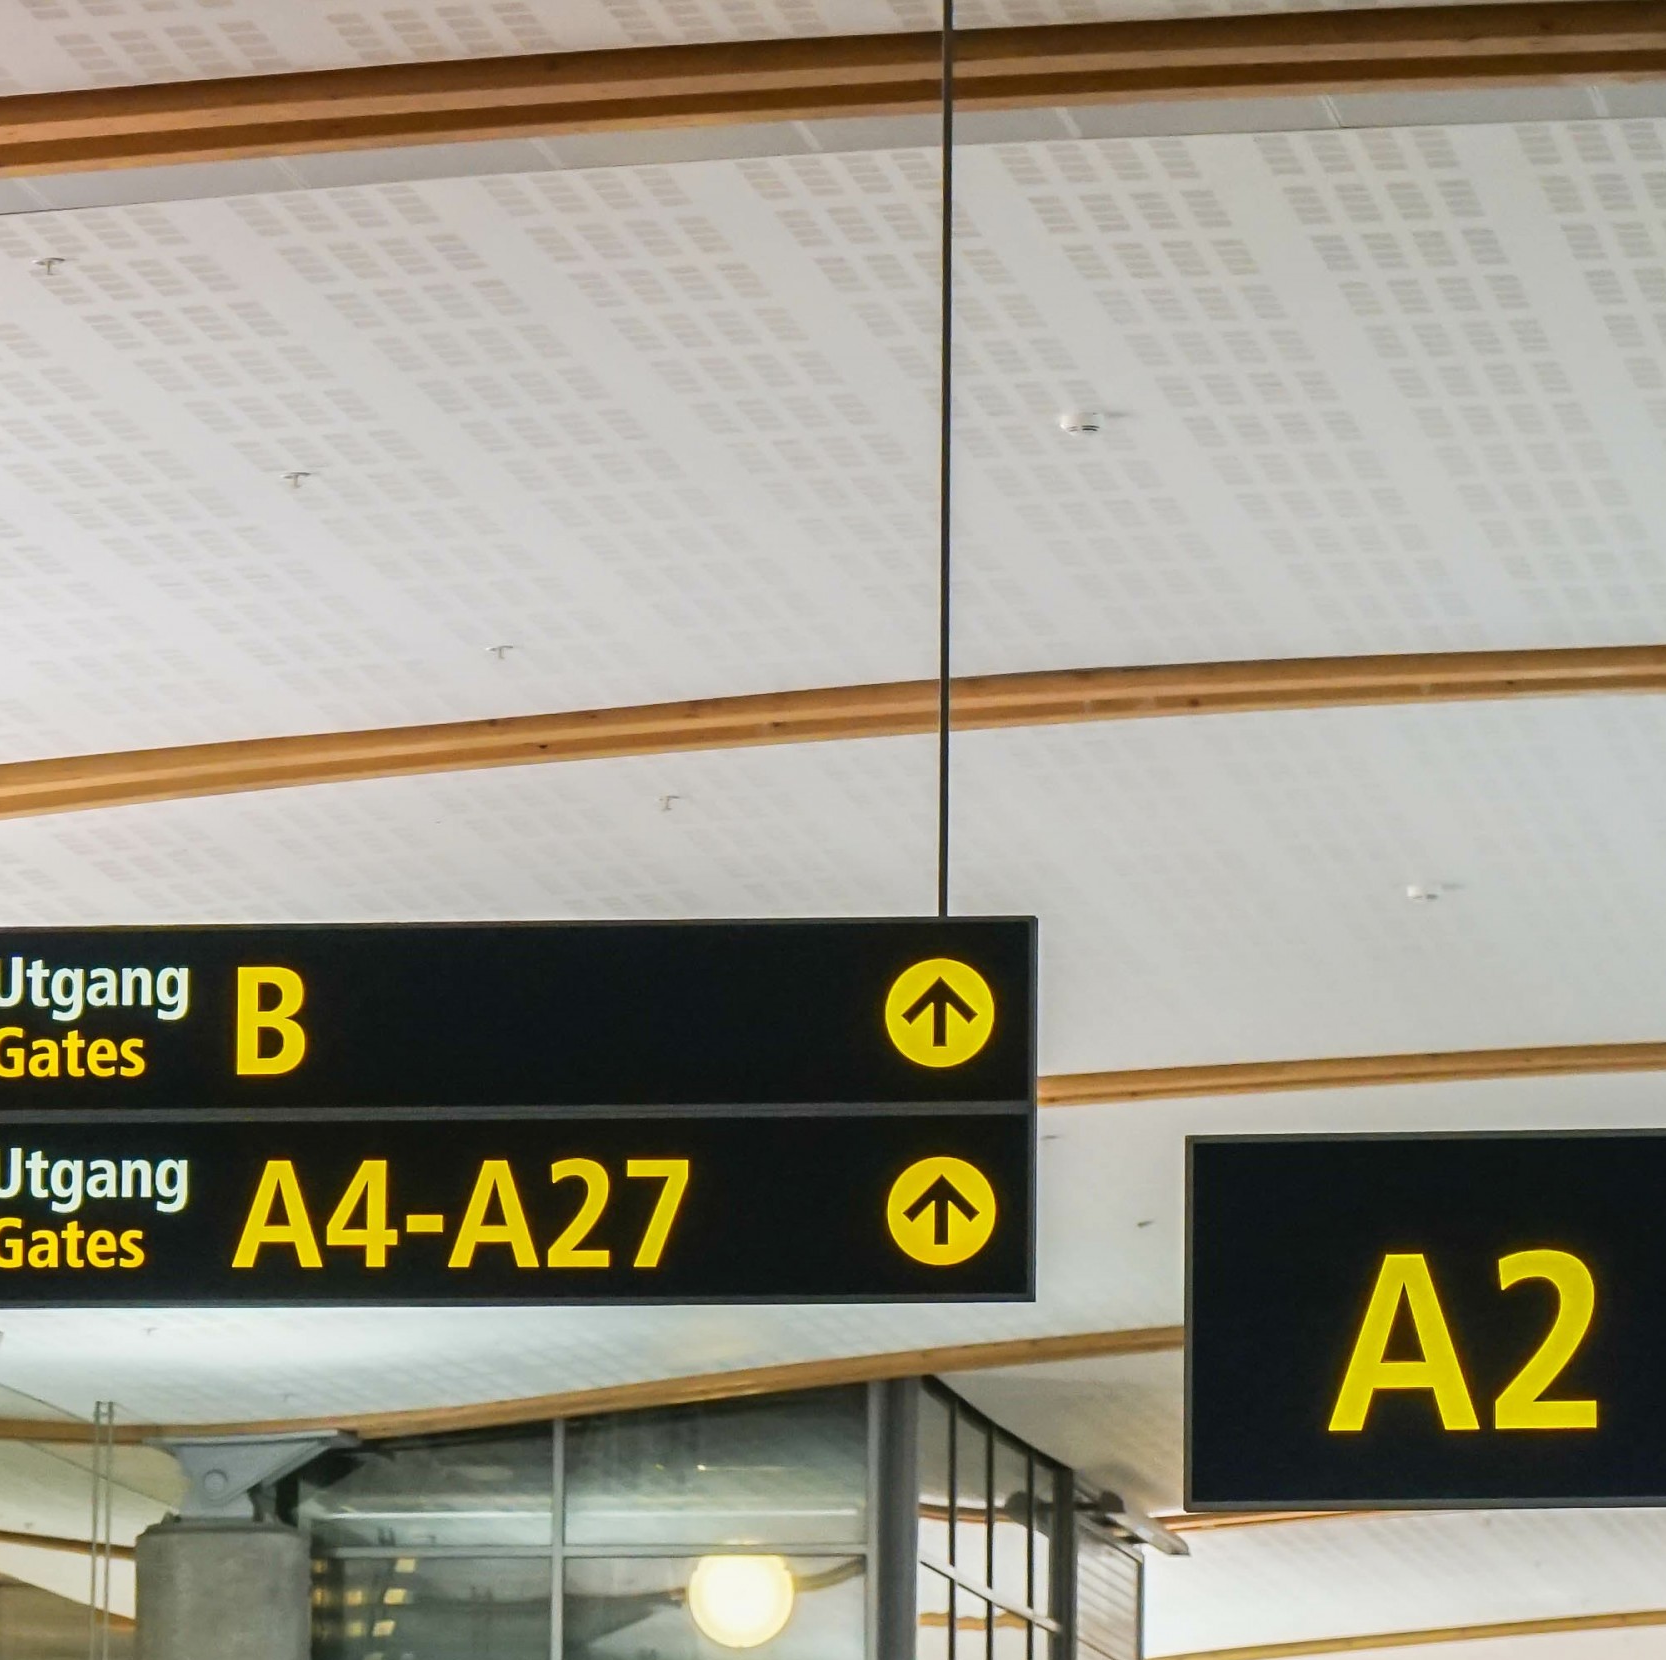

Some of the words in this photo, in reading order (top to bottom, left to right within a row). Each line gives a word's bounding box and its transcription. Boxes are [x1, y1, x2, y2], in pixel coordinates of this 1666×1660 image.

[235, 965, 308, 1076] B
[231, 1158, 691, 1269] A4-A27
[1327, 1248, 1598, 1432] A2
